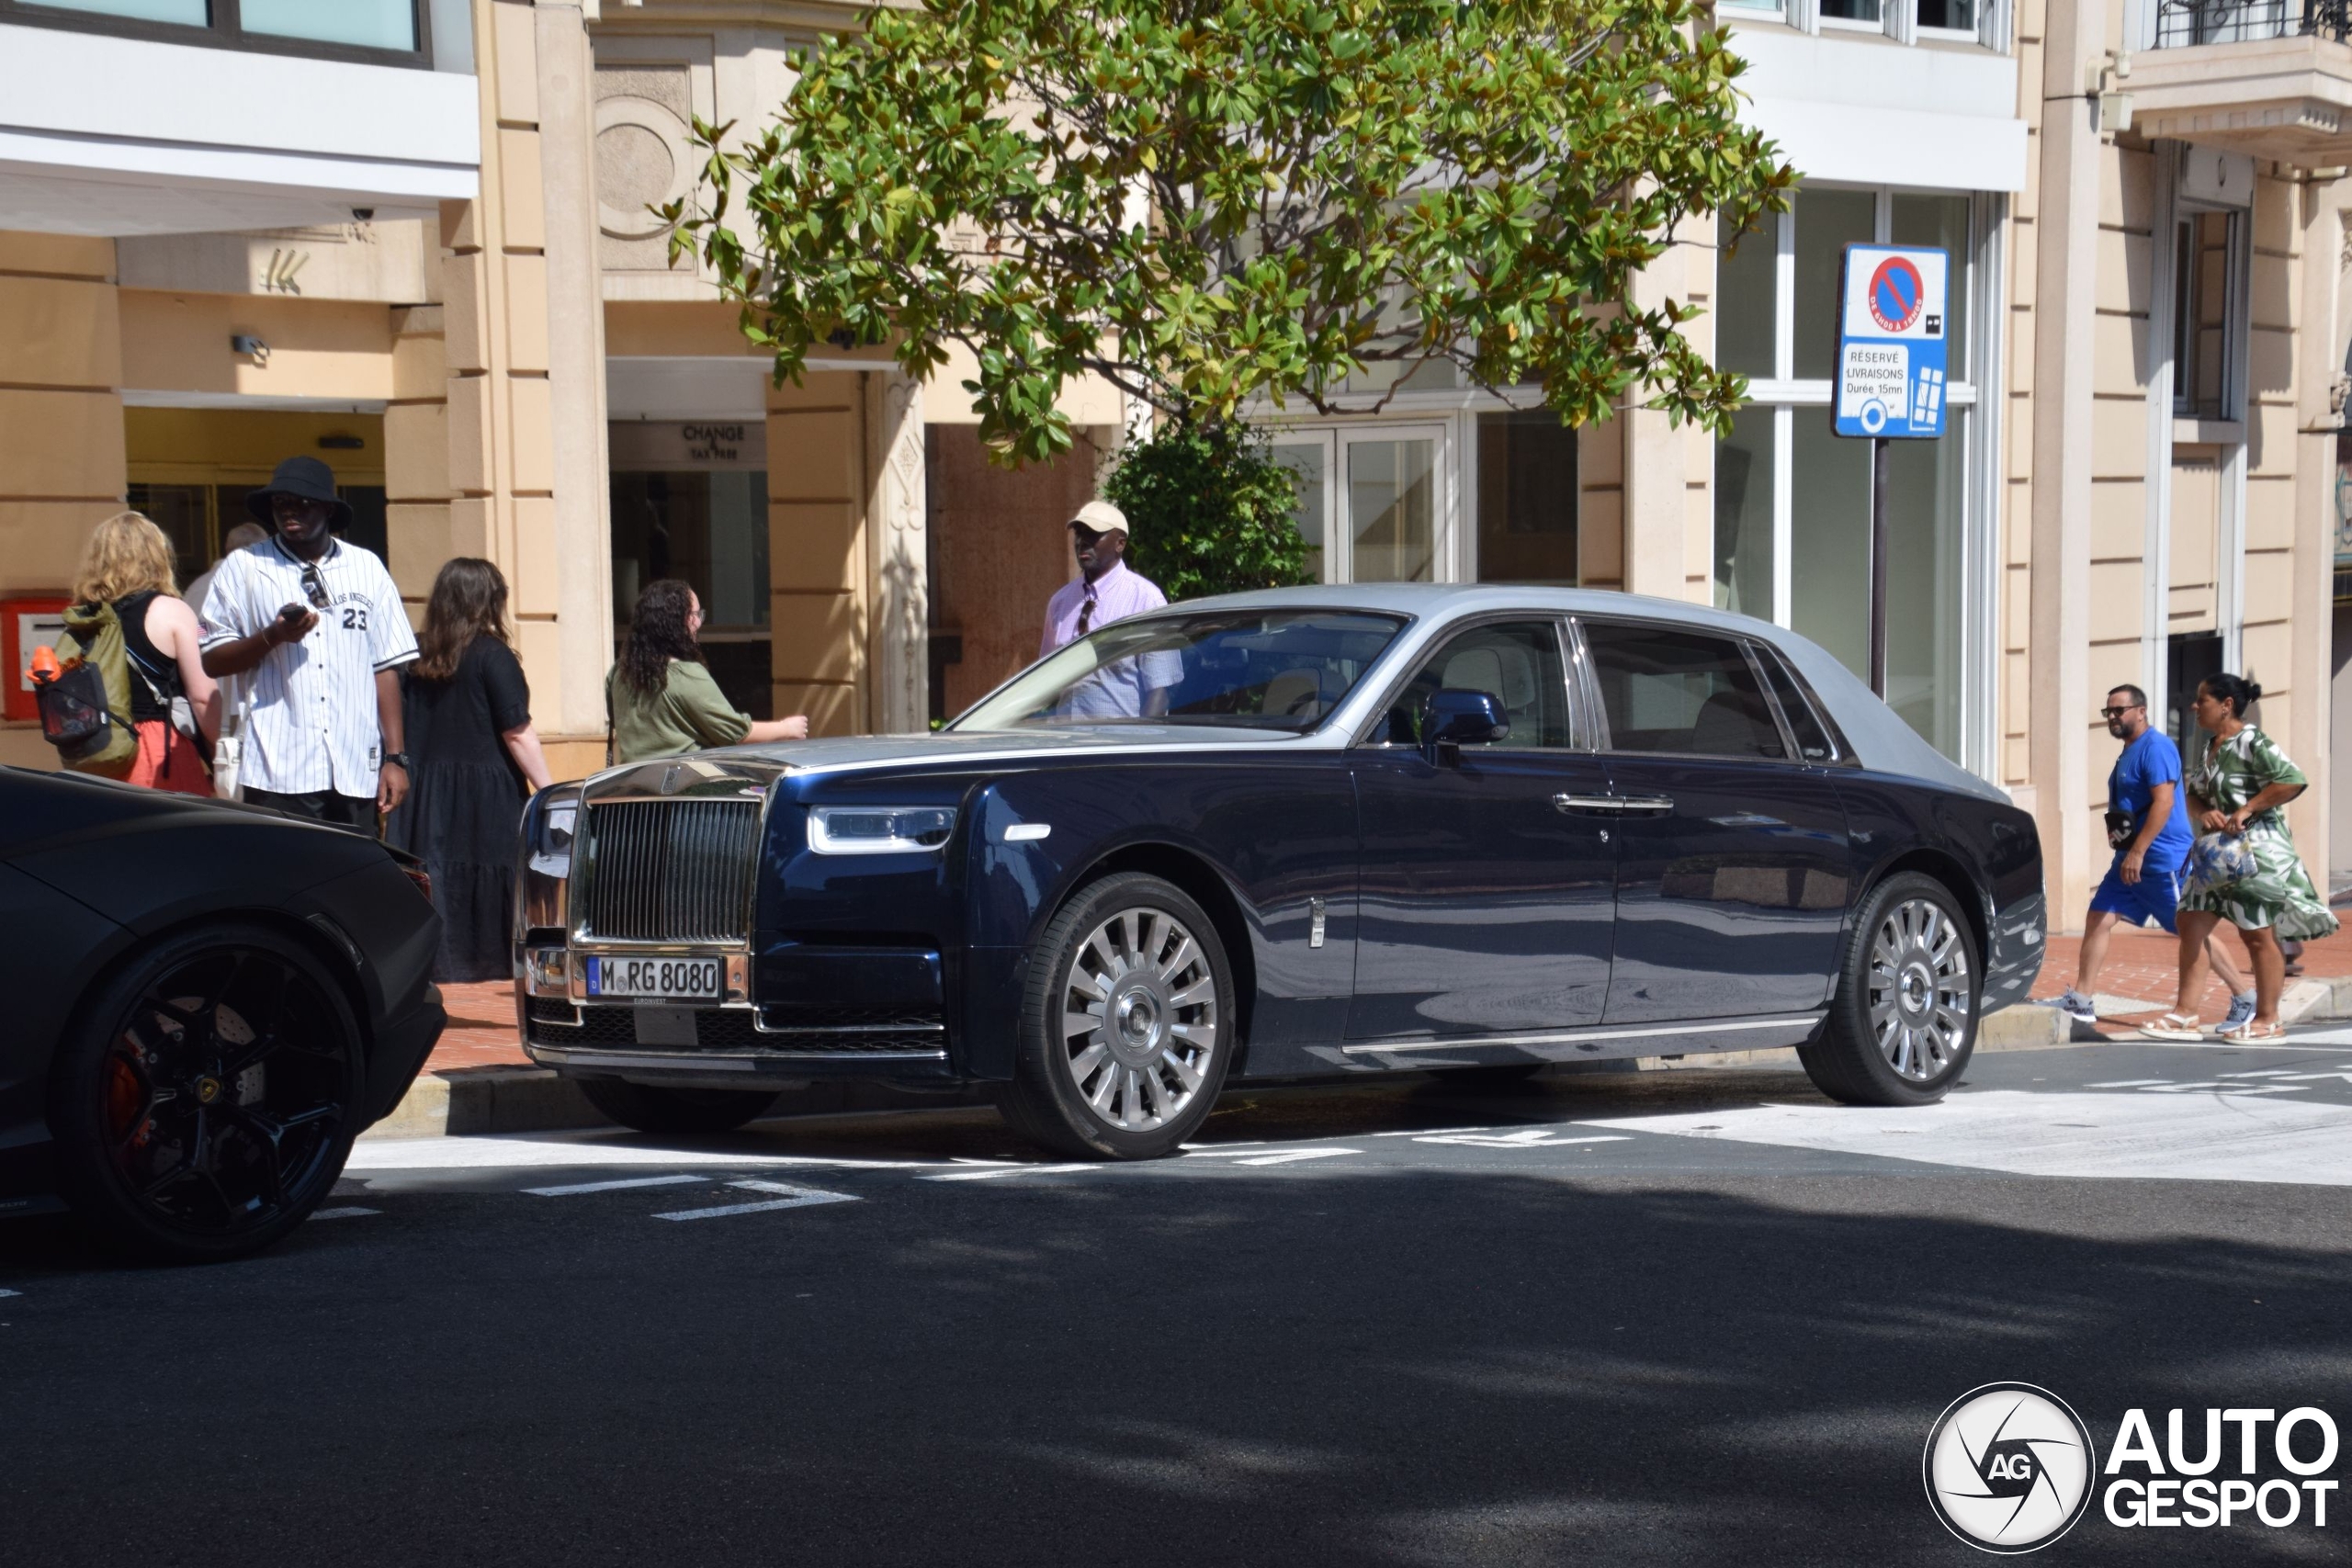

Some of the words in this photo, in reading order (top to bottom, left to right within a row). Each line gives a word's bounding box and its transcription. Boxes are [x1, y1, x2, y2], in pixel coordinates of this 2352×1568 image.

[1870, 296, 1878, 310] DE
[1850, 351, 1899, 364] RÉSERVÉ
[1847, 368, 1904, 379] LIVRAISONS
[1847, 383, 1874, 394] Durée
[1878, 384, 1903, 395] 15mn
[683, 425, 744, 441] CHANGE
[691, 448, 710, 459] TAX
[714, 448, 738, 459] FREE
[343, 608, 367, 631] 23
[601, 961, 615, 990] M
[628, 962, 656, 992] RG
[661, 963, 717, 994] 8080
[591, 980, 597, 989] D
